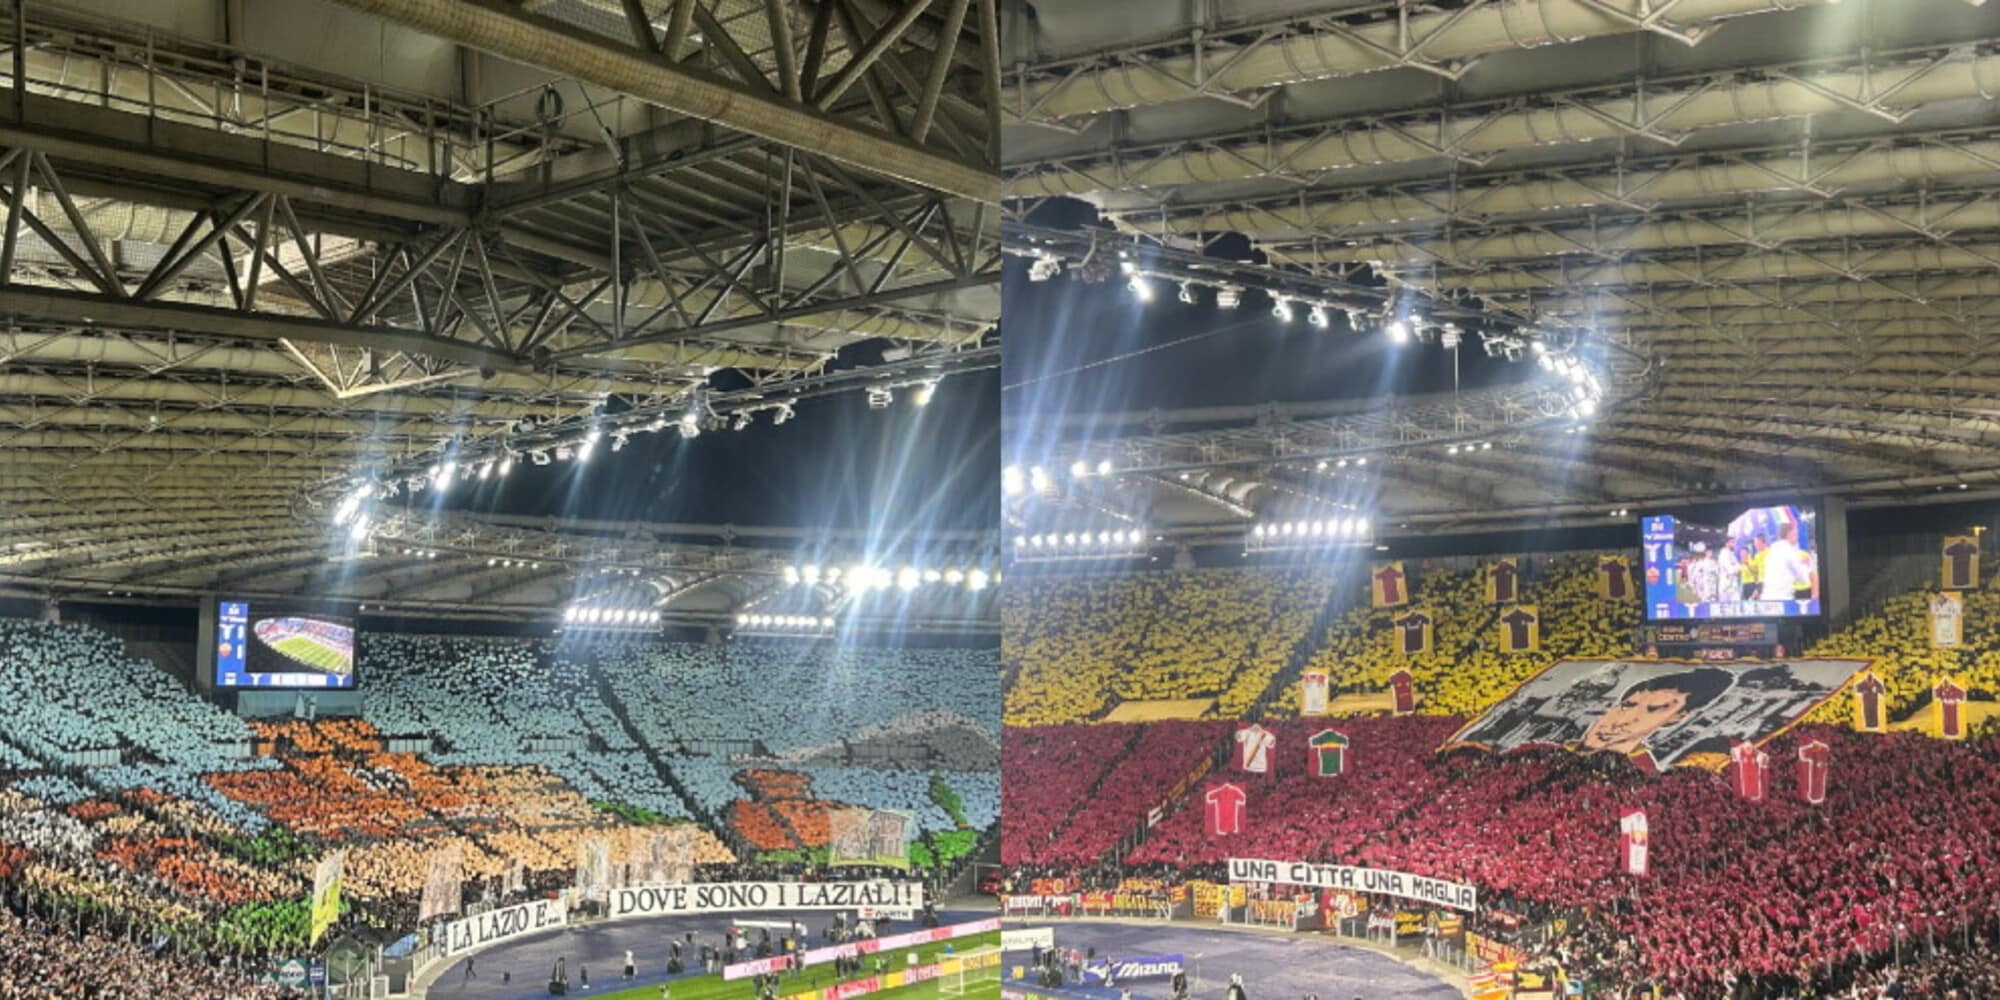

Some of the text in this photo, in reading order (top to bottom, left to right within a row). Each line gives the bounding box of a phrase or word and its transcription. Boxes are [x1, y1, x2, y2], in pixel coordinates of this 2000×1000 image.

[618, 883, 912, 914] DOVE SONO I LAZIALI!
[1233, 861, 1278, 879] UNA
[1364, 871, 1404, 893] UNA
[1412, 877, 1473, 907] MAGLIA
[453, 921, 473, 952] LA
[478, 906, 529, 943] LAZIO
